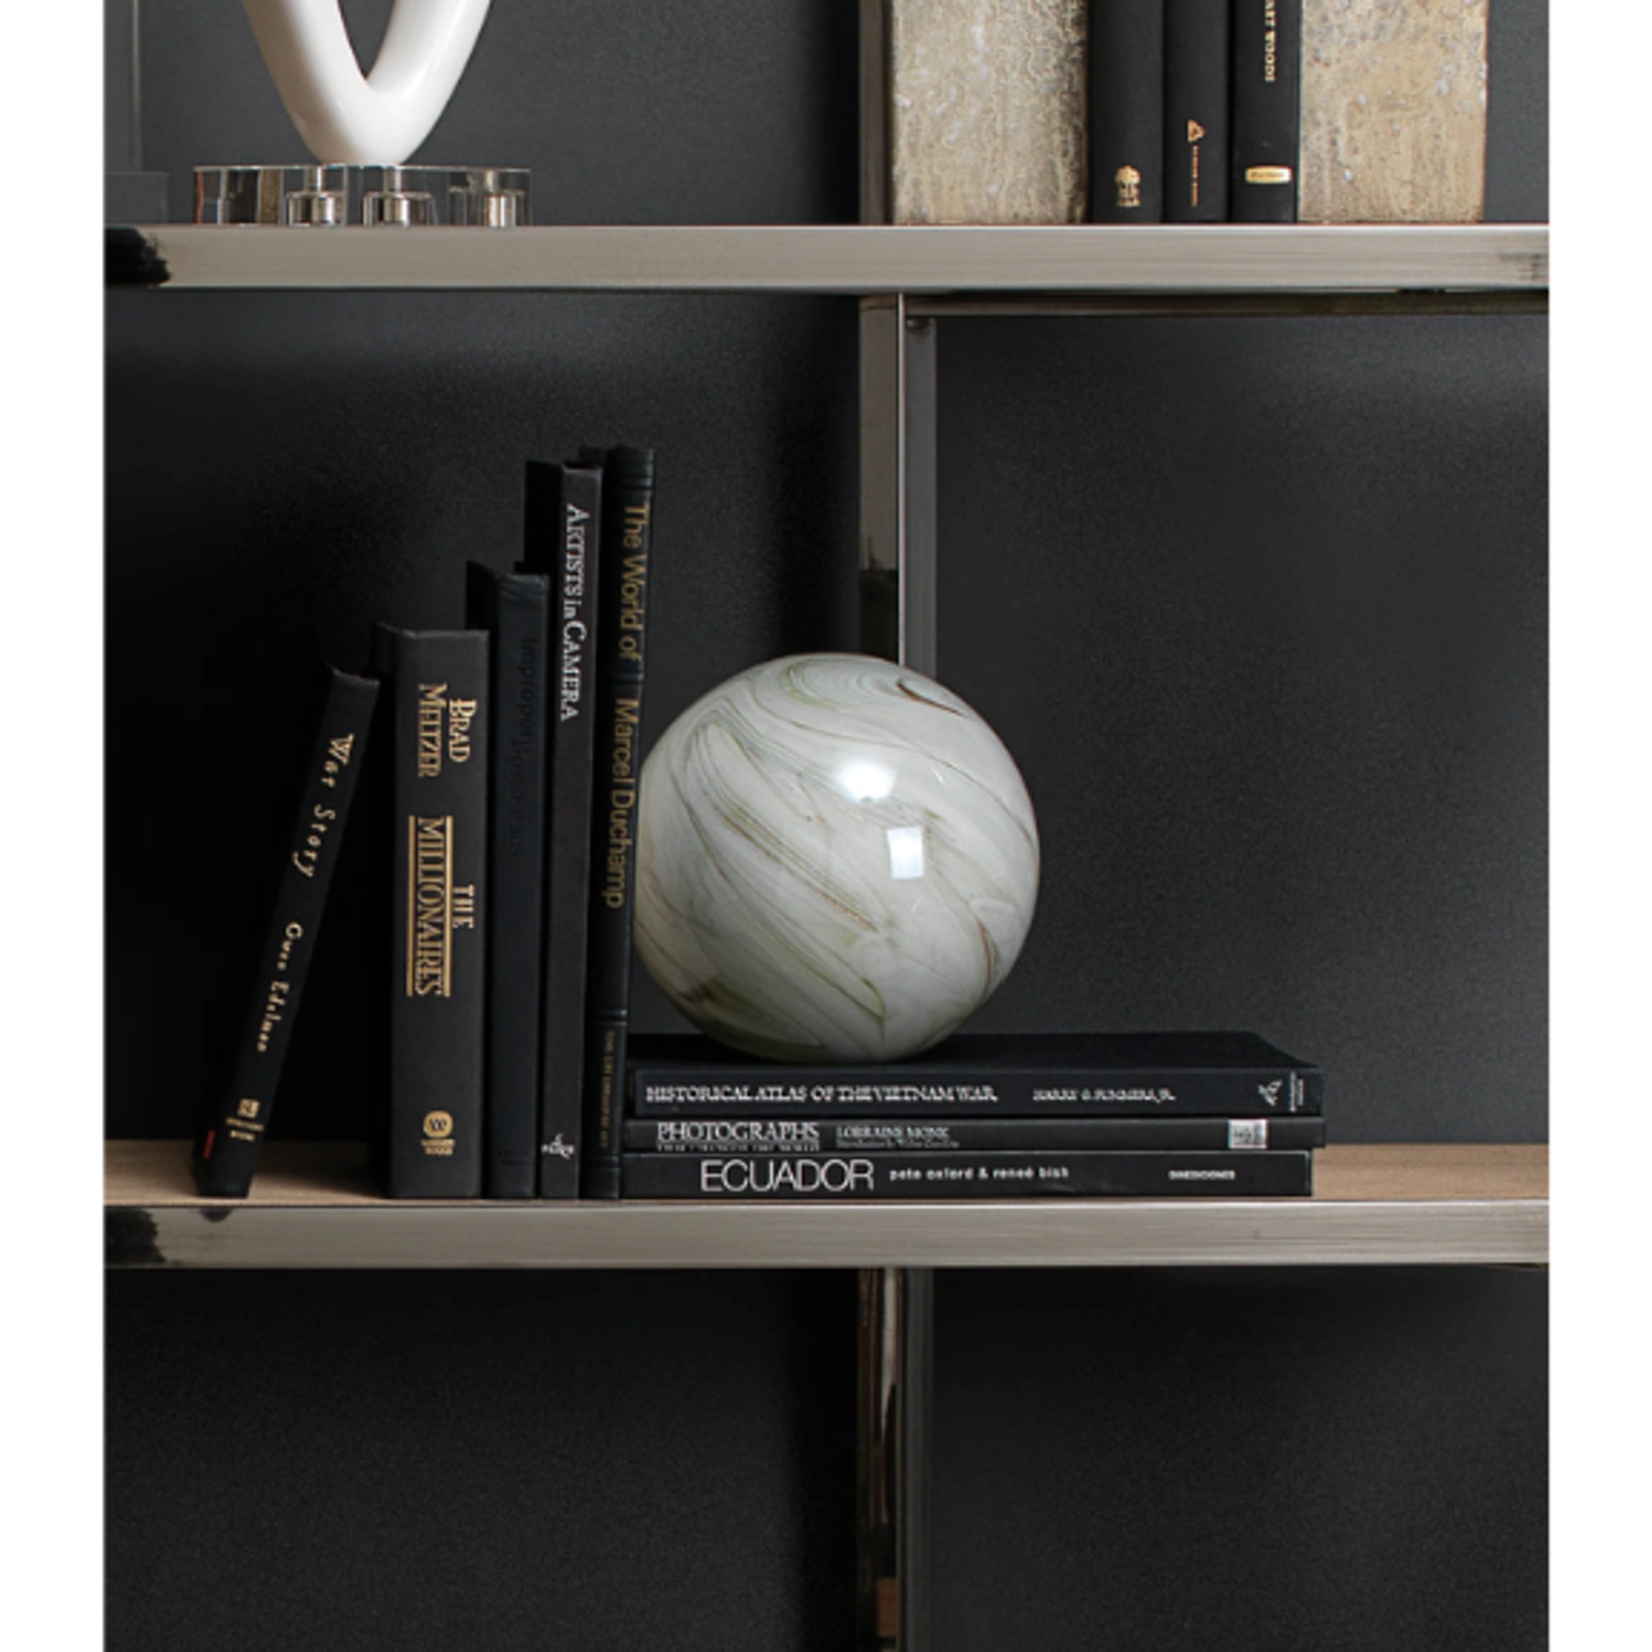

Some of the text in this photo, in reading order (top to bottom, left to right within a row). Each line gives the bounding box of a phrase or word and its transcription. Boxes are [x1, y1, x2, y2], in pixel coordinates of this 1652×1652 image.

[560, 503, 590, 722] ARTISTS in CAMERA
[617, 501, 651, 662] The World of
[417, 682, 447, 777] MELTZER
[449, 699, 477, 763] BRAD
[602, 698, 640, 909] Marcel Duchamp
[292, 804, 336, 877] Story
[415, 817, 444, 996] MILLIONAIRES
[452, 884, 475, 929] THE
[646, 1086, 752, 1103] HISTORICAL
[754, 1086, 808, 1103] ATLAS
[810, 1085, 834, 1103] OF
[838, 1085, 873, 1102] THE
[873, 1085, 955, 1102] VIETNAM
[657, 1121, 820, 1141] PHOTOGRAPHS
[701, 1159, 875, 1191] ECUADOR
